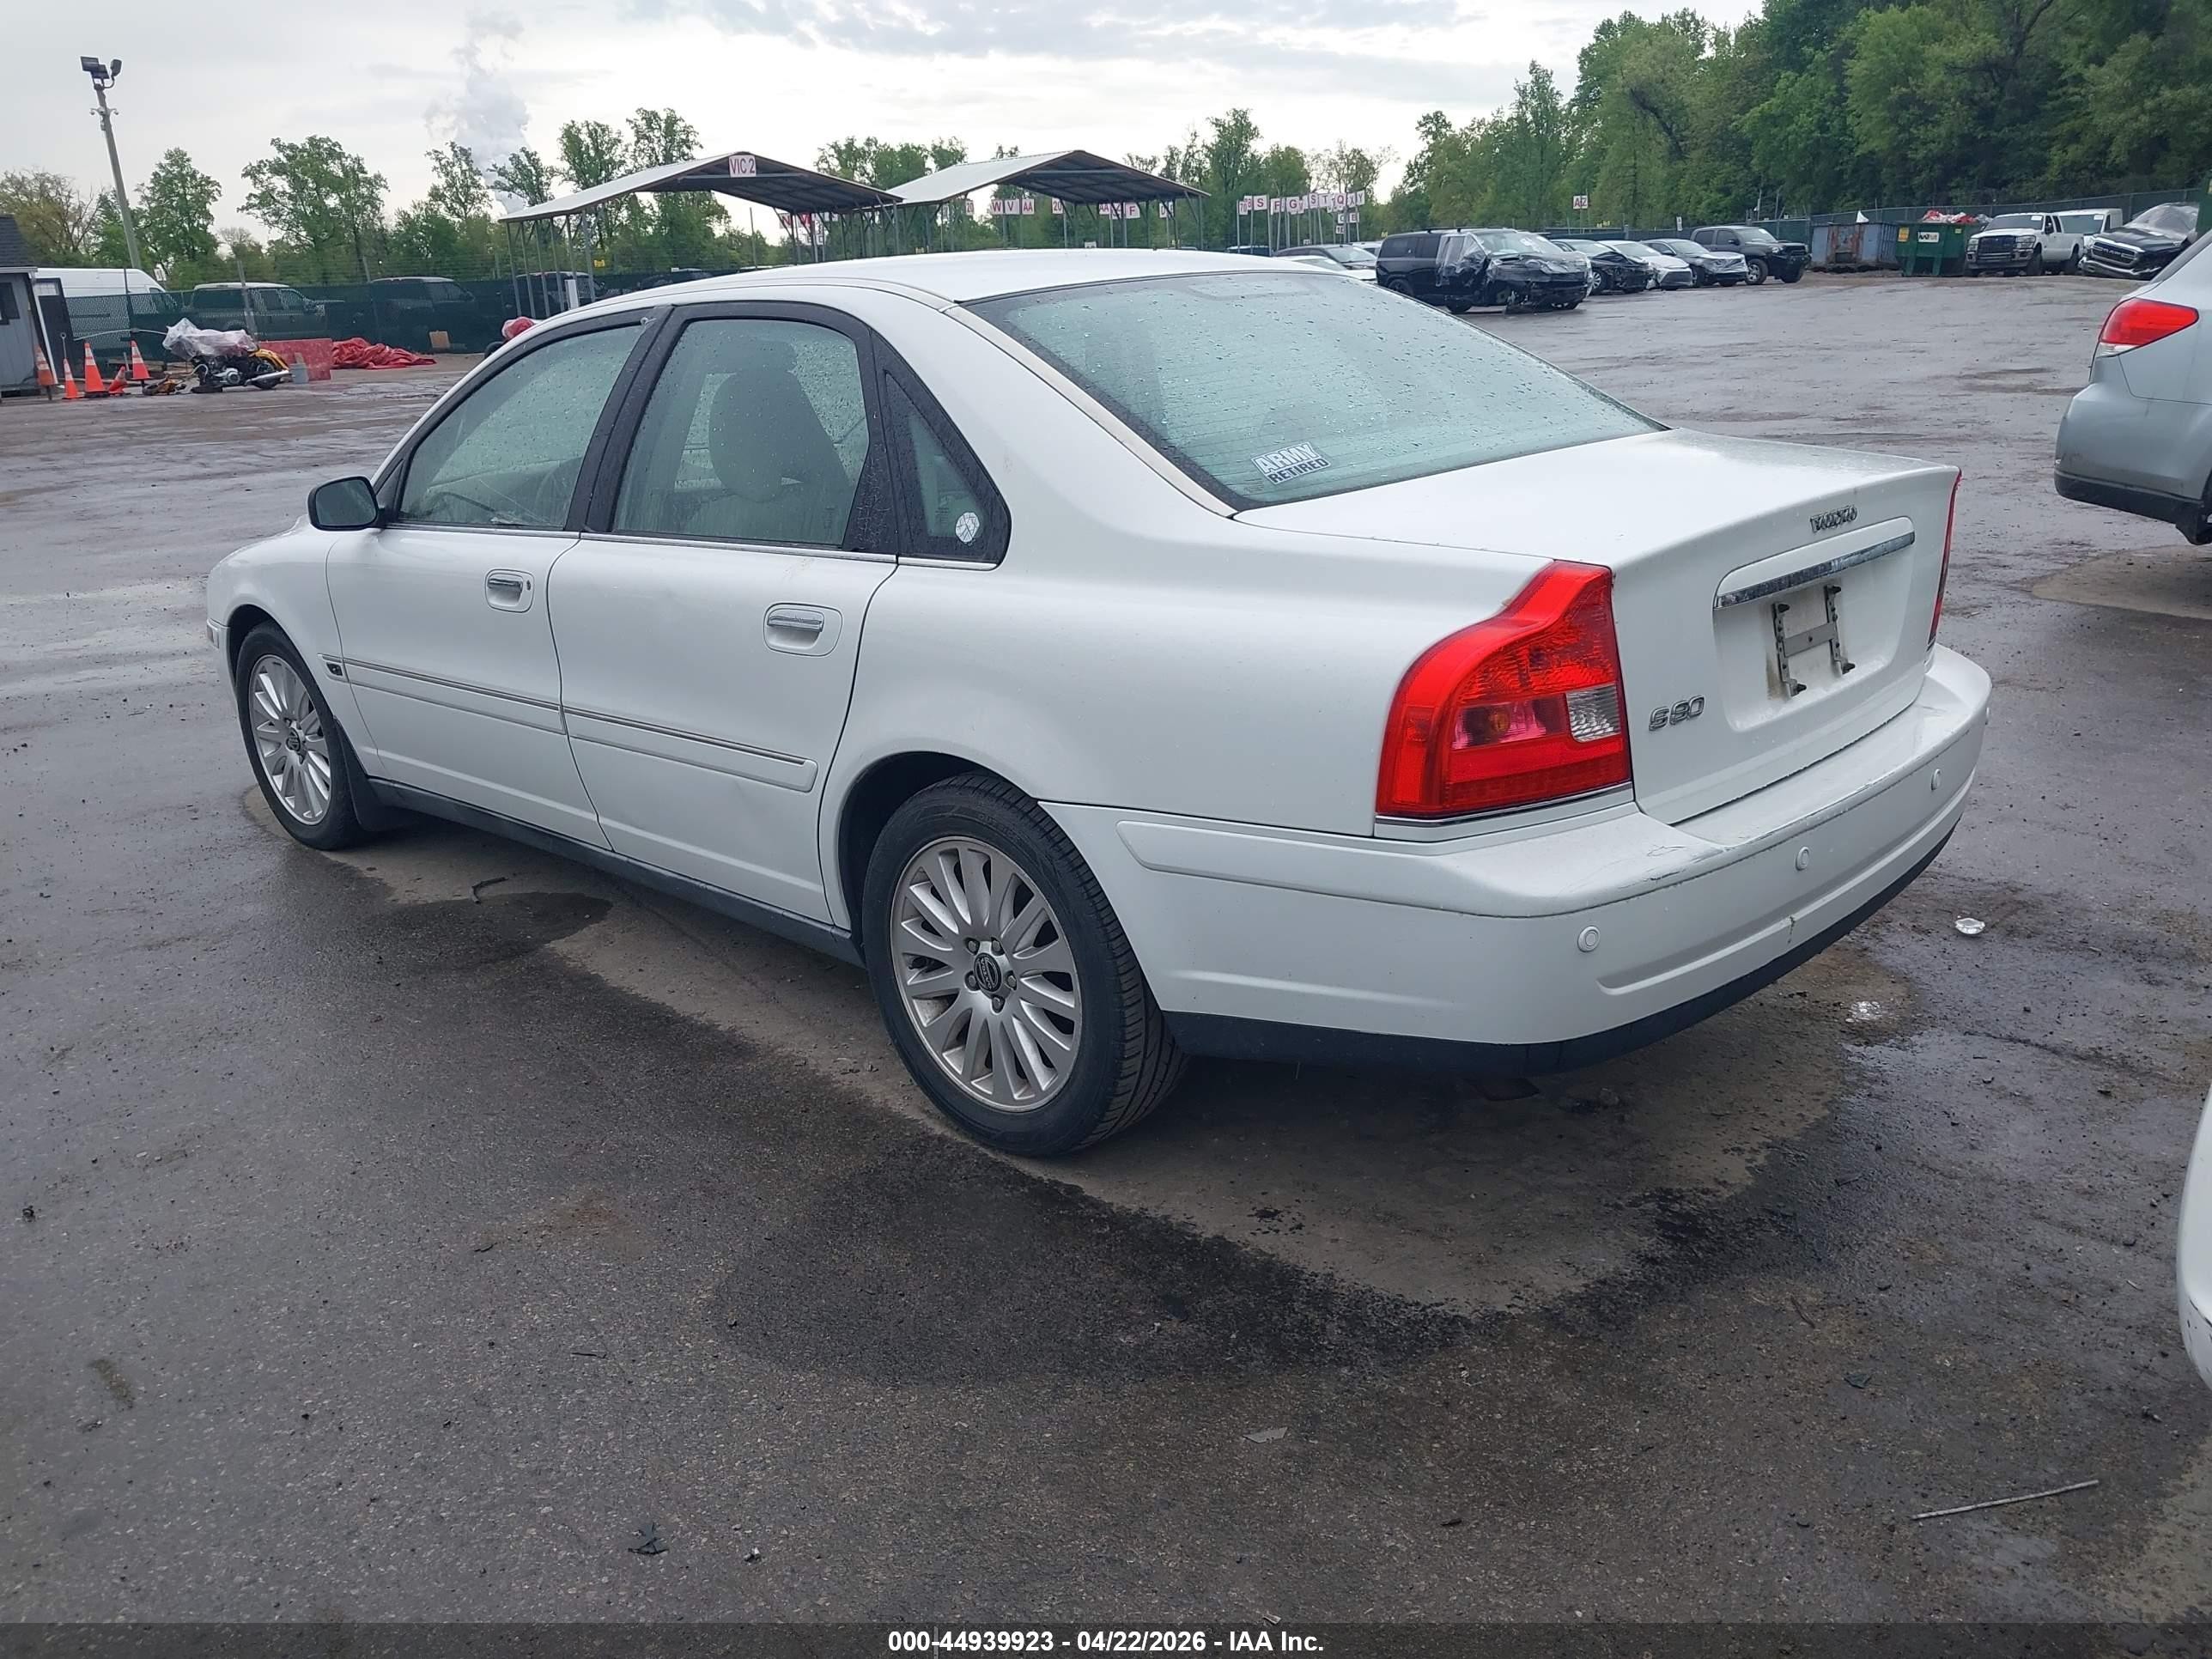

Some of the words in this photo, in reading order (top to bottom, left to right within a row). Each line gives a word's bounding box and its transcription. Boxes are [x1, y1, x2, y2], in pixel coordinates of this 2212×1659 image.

[730, 158, 747, 174] VIC
[749, 158, 755, 173] 2
[1257, 198, 1264, 207] S
[1289, 199, 1297, 209] G
[1310, 195, 1316, 204] S
[1337, 195, 1345, 204] Q
[992, 203, 1001, 212] W
[1008, 202, 1014, 211] V
[1023, 201, 1033, 212] AA
[1129, 206, 1136, 216] F
[1255, 444, 1317, 473] ARMY
[1267, 458, 1330, 483] RETIRED
[1649, 696, 1705, 731] S80
